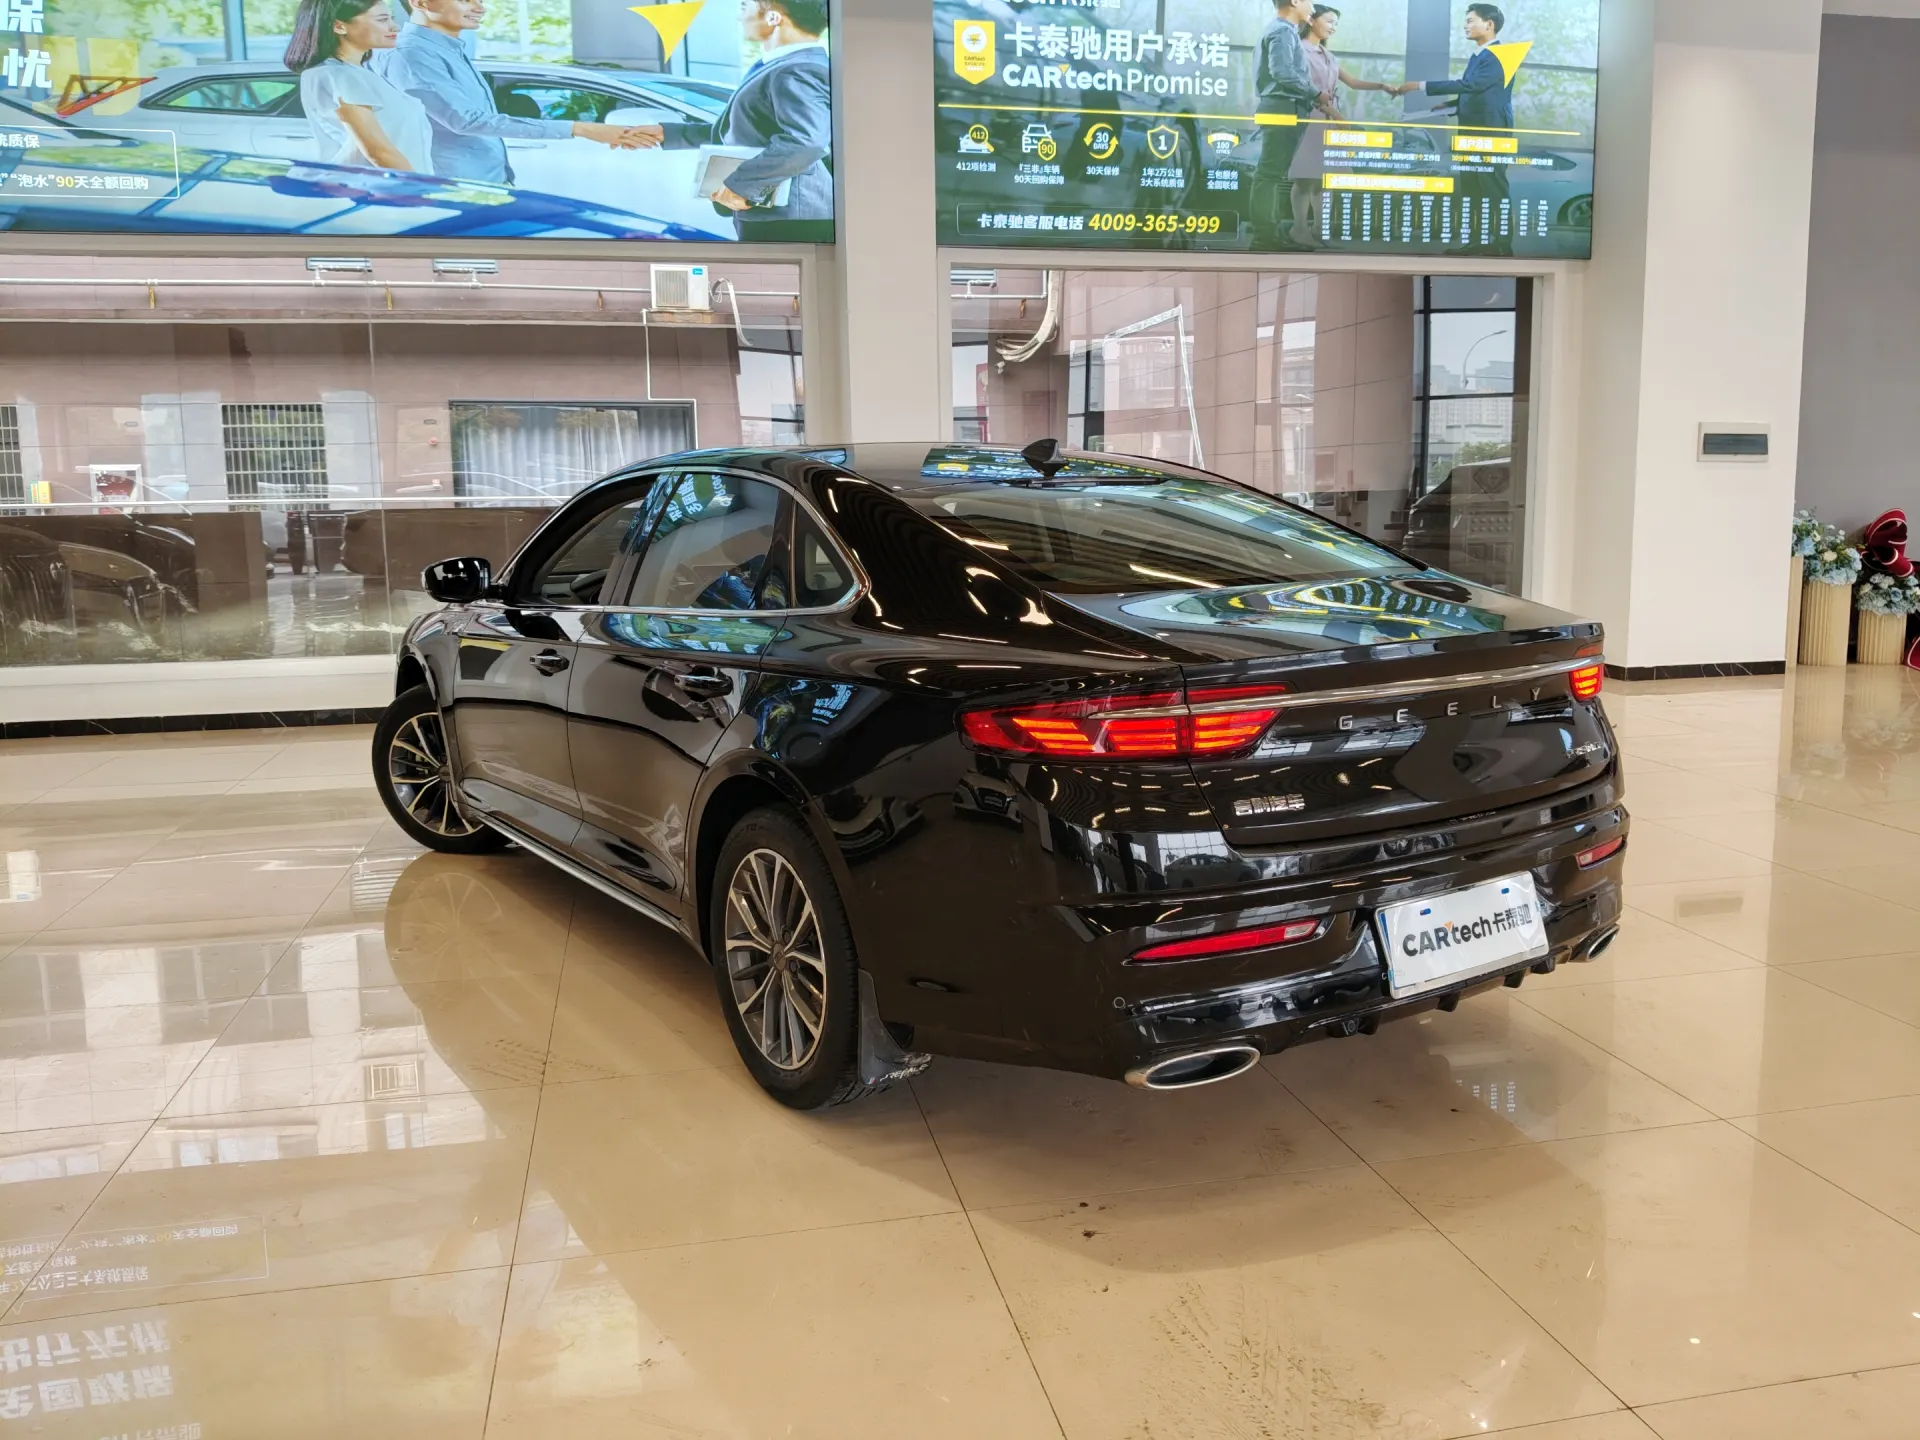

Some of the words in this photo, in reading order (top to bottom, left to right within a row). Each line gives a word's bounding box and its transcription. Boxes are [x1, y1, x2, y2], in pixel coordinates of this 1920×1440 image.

[1004, 22, 1230, 67] 卡泰驰用户承诺
[2, 48, 52, 88] 忧
[1002, 64, 1122, 91] CARtech
[1127, 68, 1228, 97] Promise
[971, 131, 985, 139] 412
[1095, 132, 1109, 142] 30
[1159, 136, 1167, 150] 1
[1041, 144, 1053, 154] 90
[956, 162, 996, 172] 412项检测
[1086, 166, 1120, 177] 30天保修
[1142, 168, 1183, 178] 1年2万公里
[1140, 178, 1185, 189] 3大系统质保
[977, 214, 1084, 231] 卡泰驰客服电话
[1088, 213, 1221, 234] 4009-365-999
[1336, 687, 1541, 731] GEELY
